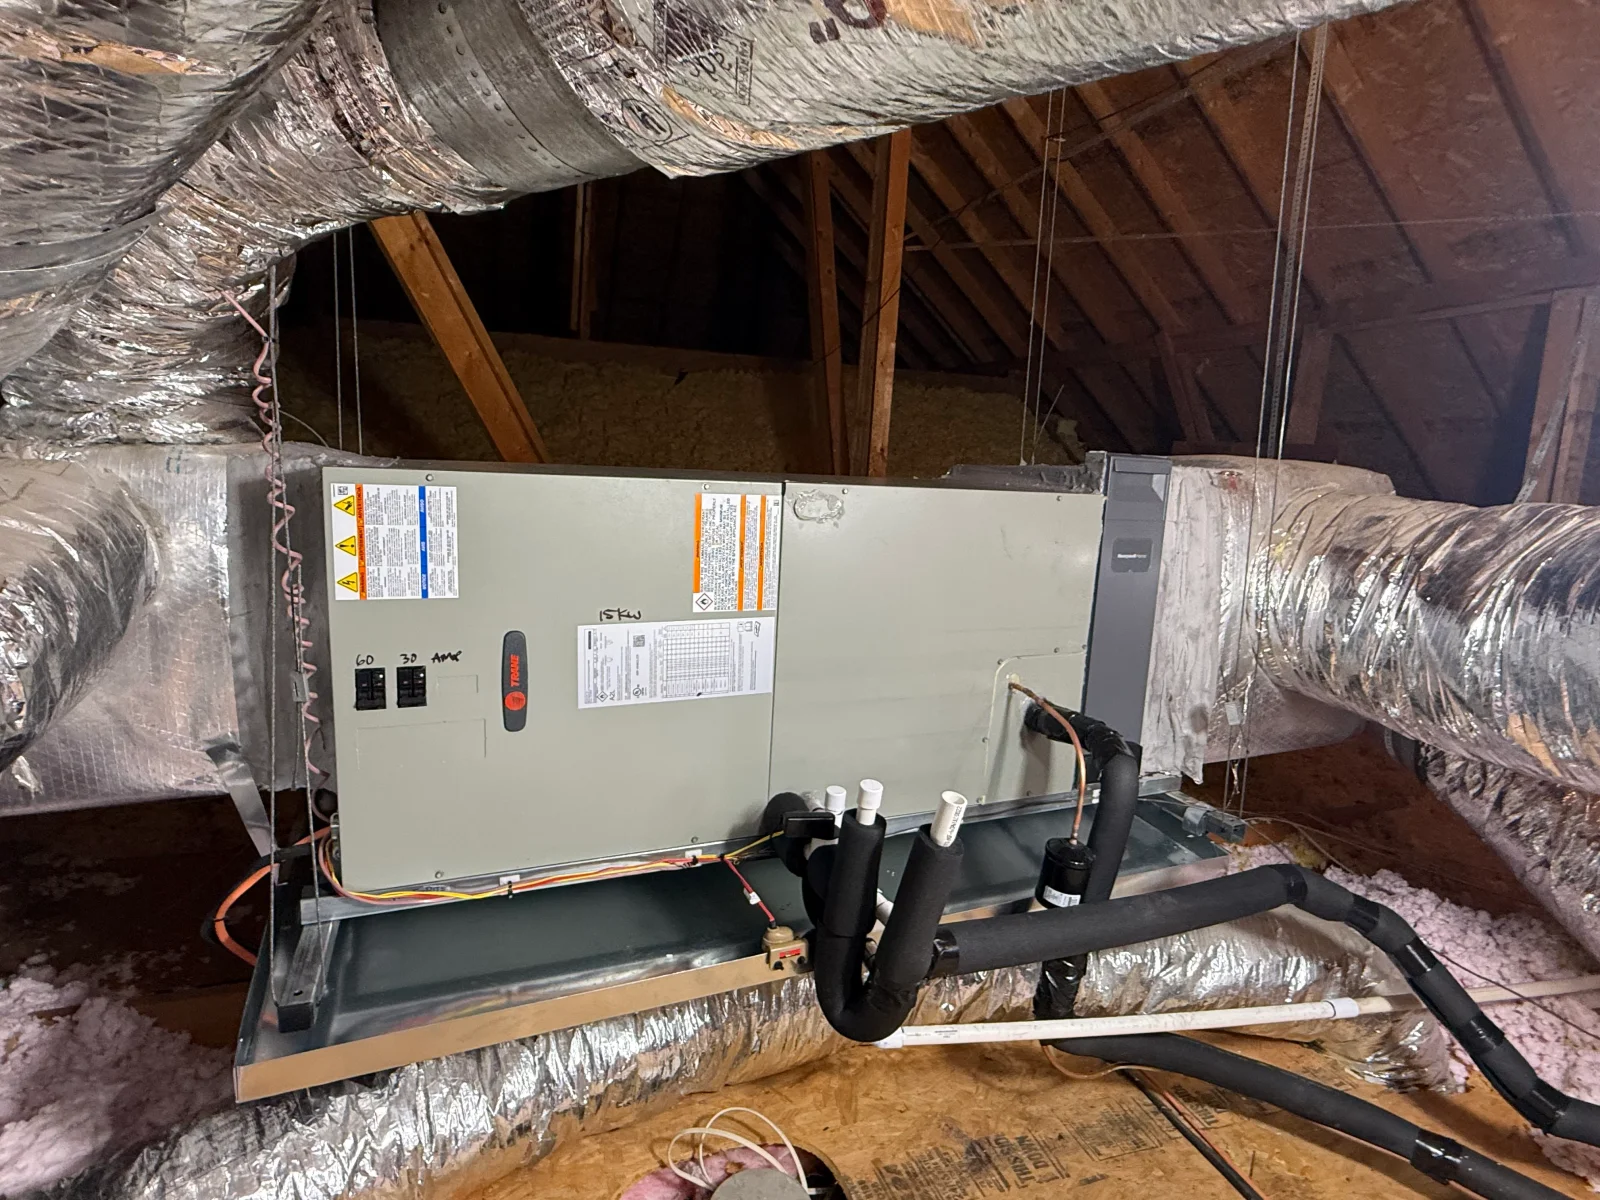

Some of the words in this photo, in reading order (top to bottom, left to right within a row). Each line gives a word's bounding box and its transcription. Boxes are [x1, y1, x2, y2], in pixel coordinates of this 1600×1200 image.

[356, 654, 374, 666] 60
[400, 653, 418, 664] 30
[510, 654, 520, 688] TRANE
[1014, 1134, 1049, 1171] DOWN
[1008, 1158, 1036, 1184] THIS
